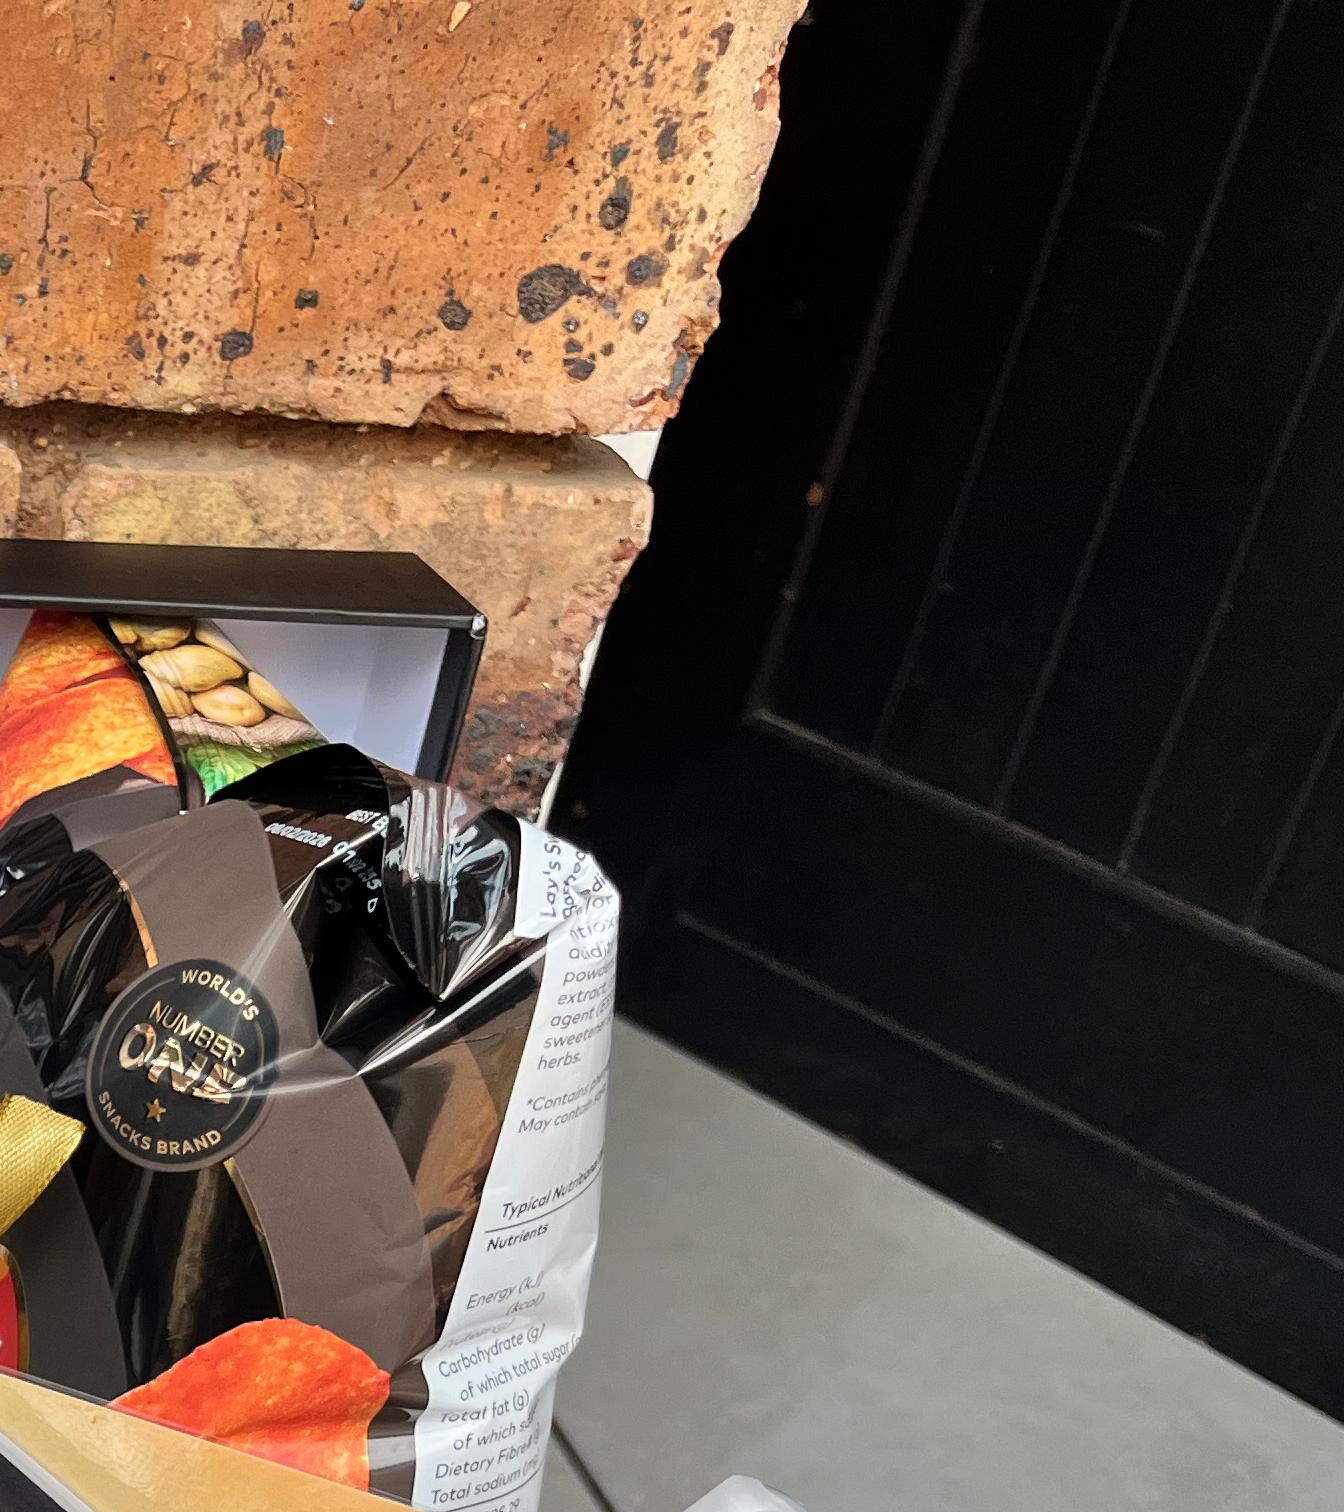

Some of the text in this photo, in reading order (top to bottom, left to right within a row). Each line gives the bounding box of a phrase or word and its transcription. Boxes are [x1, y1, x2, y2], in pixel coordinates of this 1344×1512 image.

[181, 969, 260, 1022] WORLD'S
[149, 1000, 246, 1068] NUMBER
[118, 1022, 248, 1105] ONE
[98, 1090, 222, 1156] SNACKS BRAND
[518, 1116, 552, 1135] May
[501, 1189, 552, 1221] Typical
[486, 1222, 550, 1252] Nutrients
[465, 1284, 516, 1311] Energy
[437, 1334, 525, 1378] Carbohydrate
[526, 1322, 546, 1345] (g)
[459, 1380, 475, 1402] of
[477, 1368, 513, 1395] which
[512, 1355, 543, 1379] total
[491, 1398, 511, 1420] fat
[512, 1388, 530, 1413] (g)
[452, 1431, 473, 1451] of
[477, 1422, 516, 1447] which
[434, 1454, 495, 1481] Dietary
[430, 1468, 522, 1506] Total sodium
